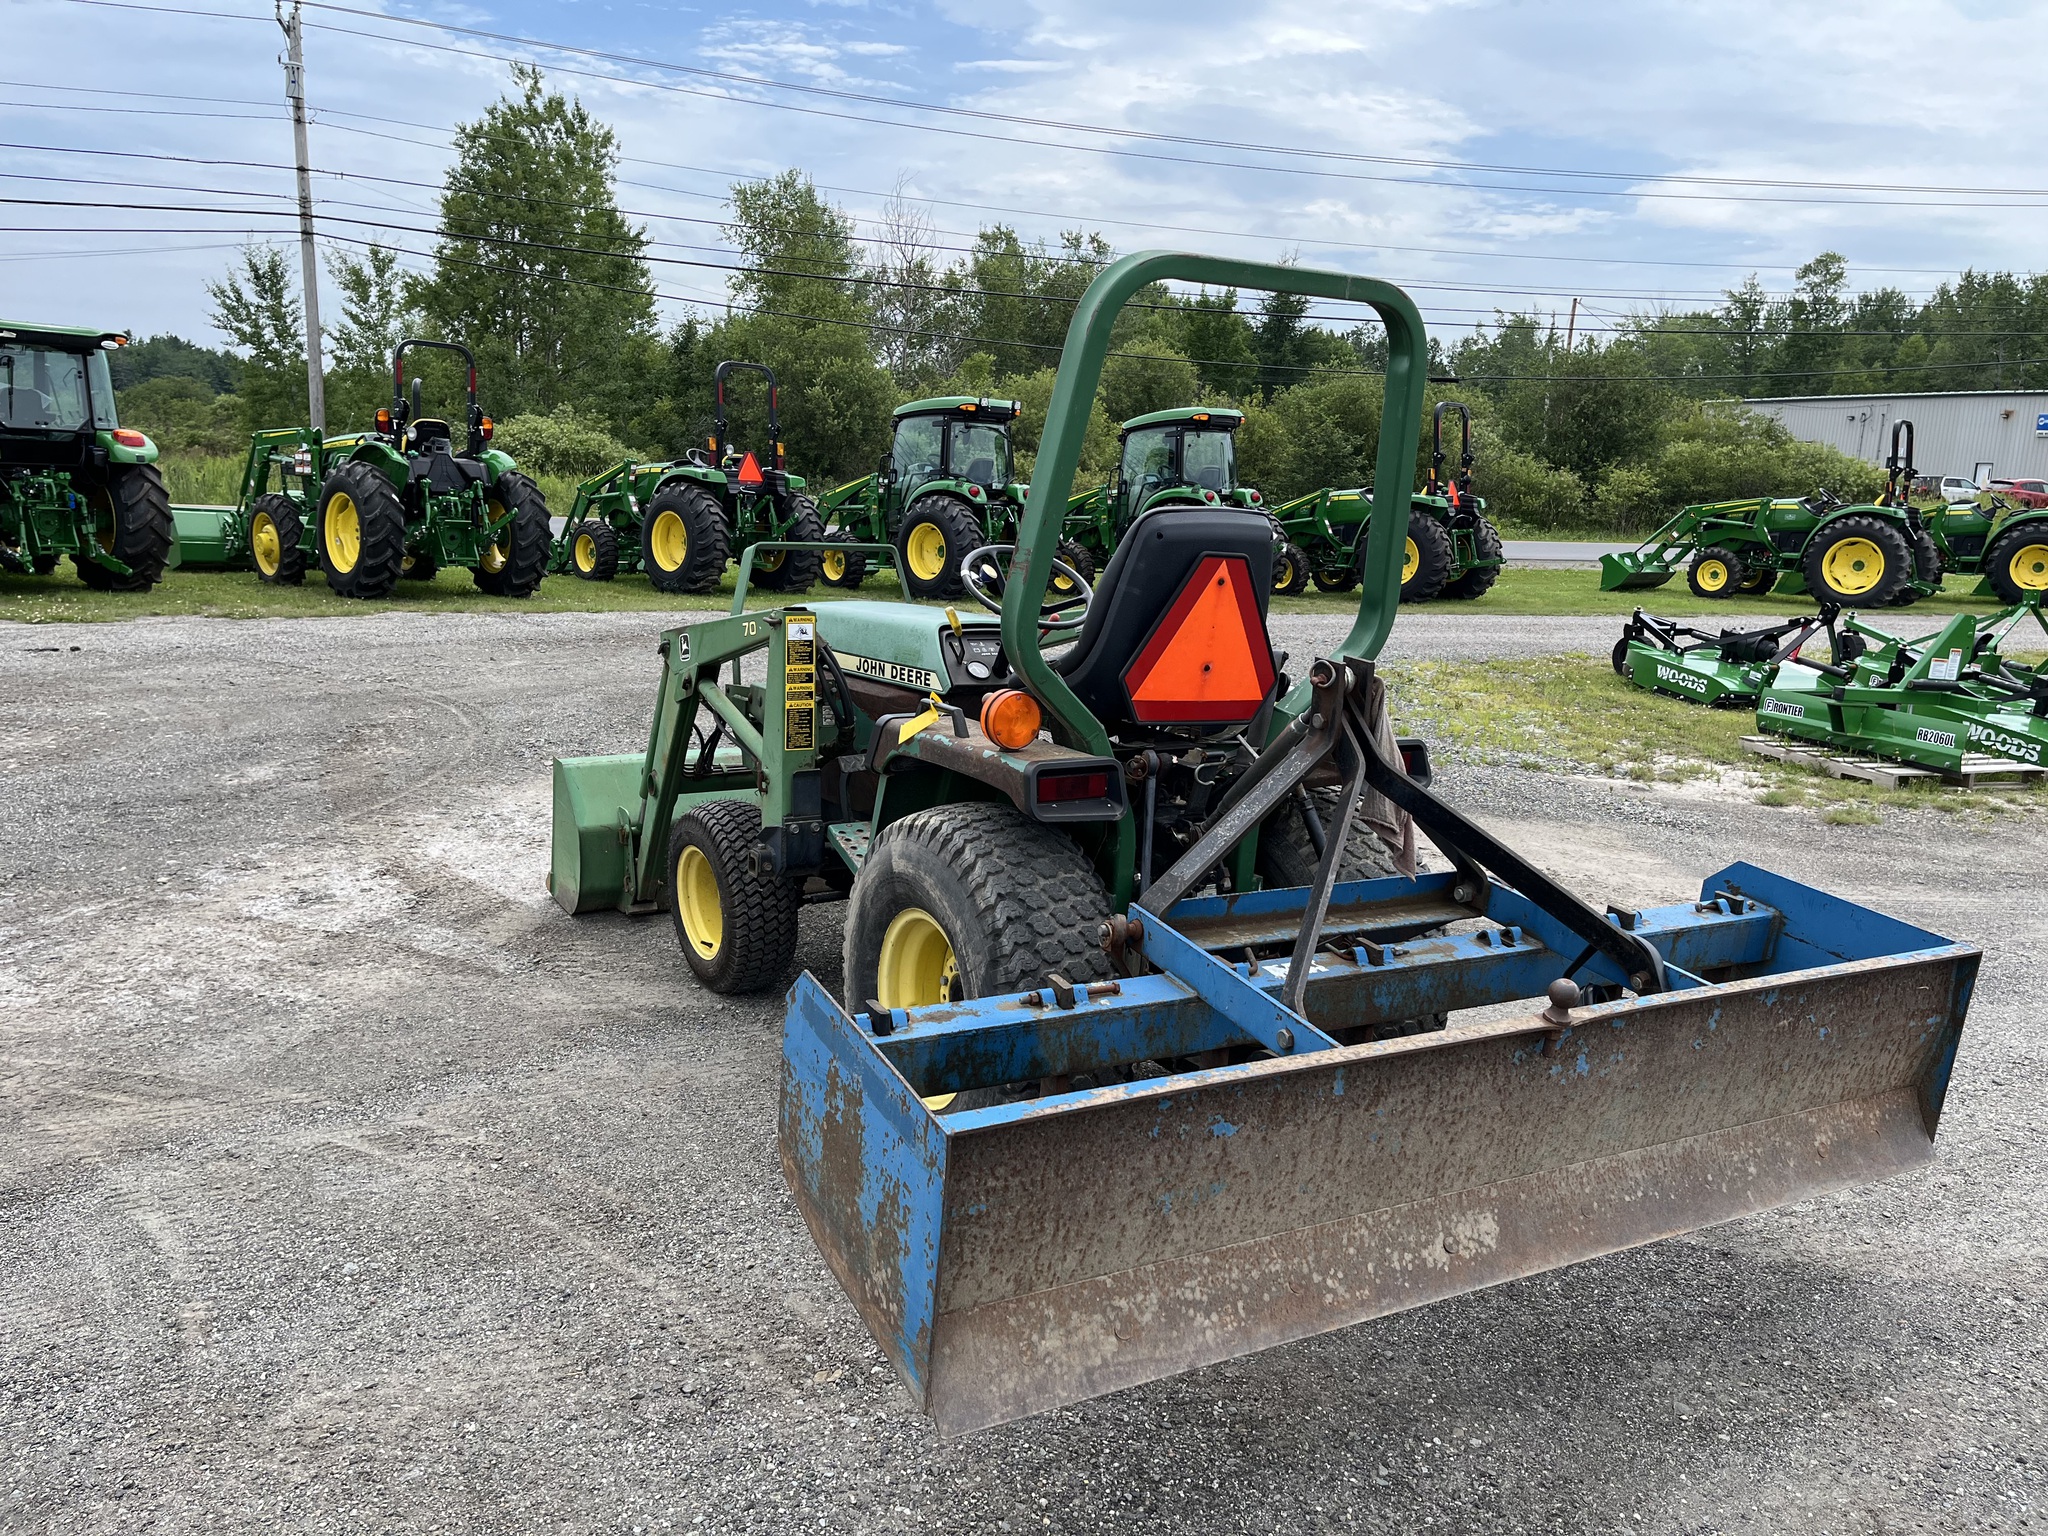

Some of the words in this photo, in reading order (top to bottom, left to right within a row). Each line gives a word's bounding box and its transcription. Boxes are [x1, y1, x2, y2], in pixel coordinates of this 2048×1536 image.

[742, 621, 757, 637] 70
[856, 658, 885, 677] JOHN
[890, 665, 931, 687] DEERE
[1656, 664, 1708, 694] WOODS
[1764, 698, 1803, 717] FRONTIER
[1917, 728, 1955, 747] RB2060L
[1963, 720, 2041, 762] WOODS
